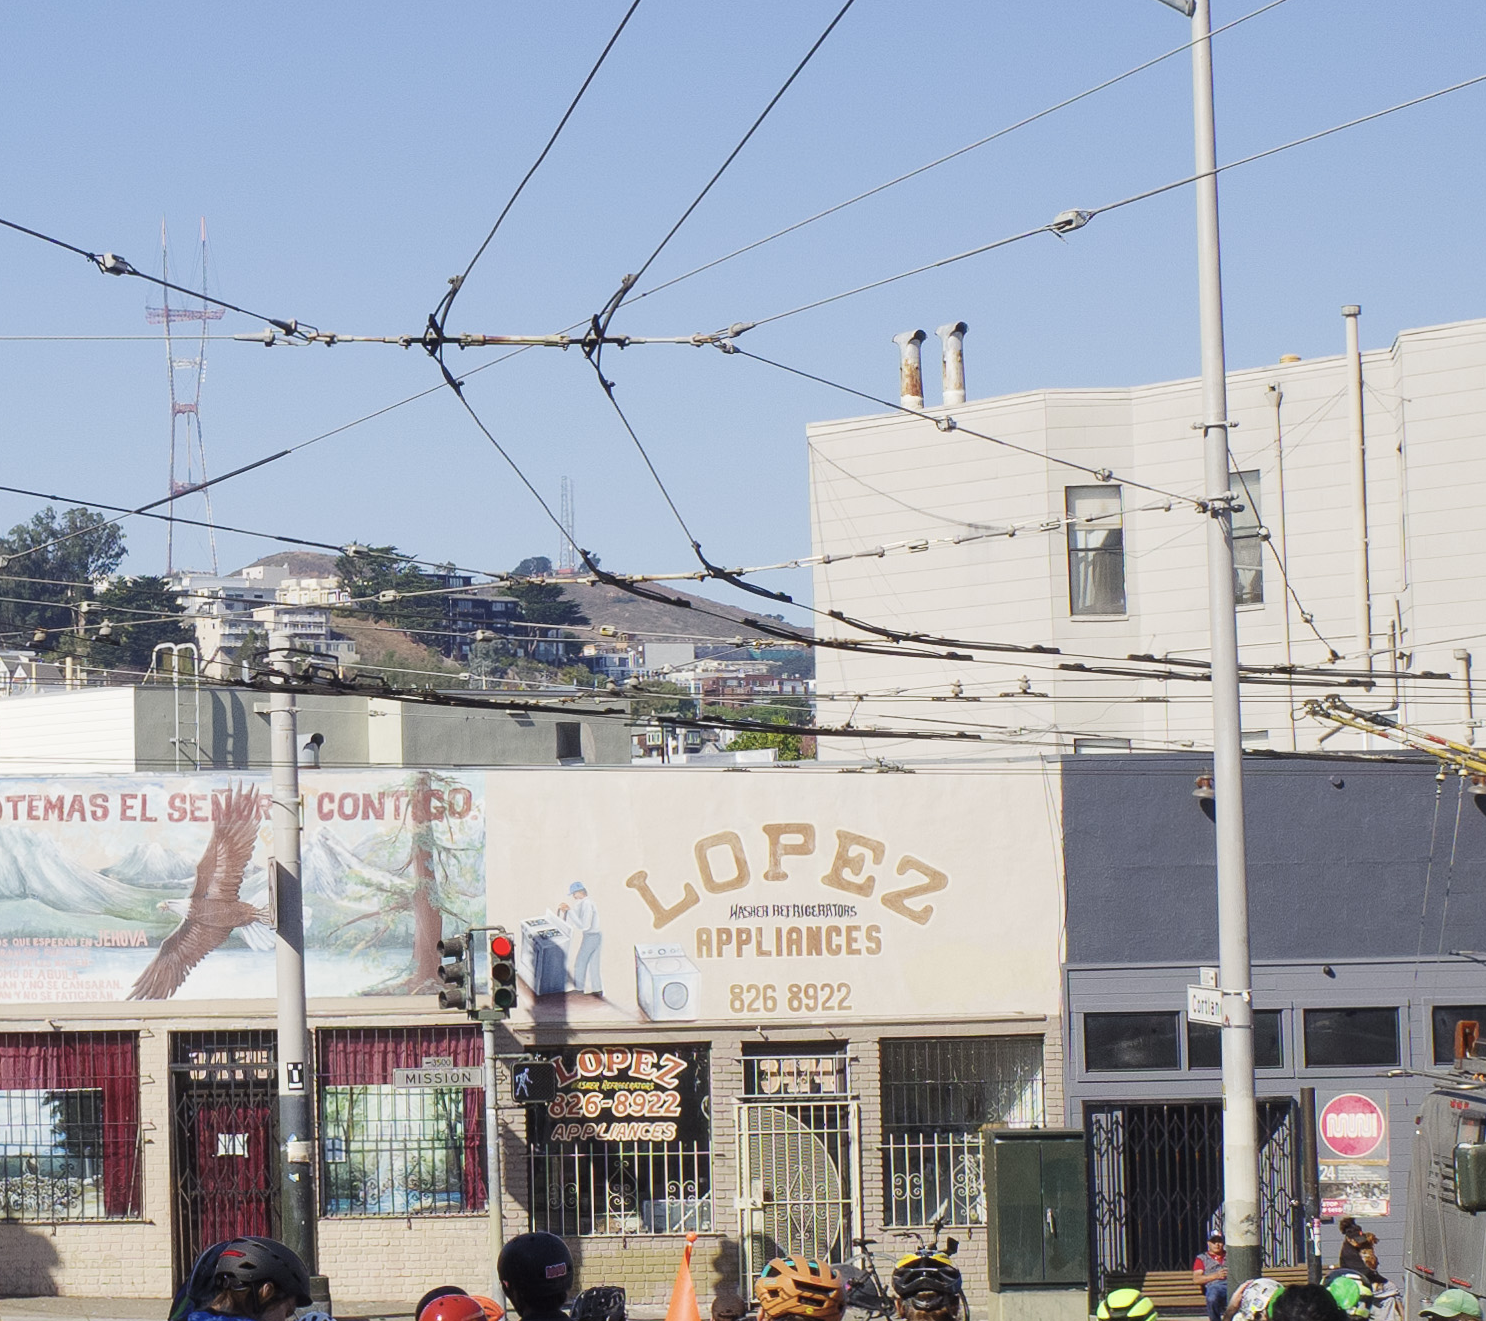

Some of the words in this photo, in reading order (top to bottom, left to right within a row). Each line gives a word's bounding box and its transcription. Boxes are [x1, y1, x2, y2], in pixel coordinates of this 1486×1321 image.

[119, 793, 157, 822] EL
[626, 822, 948, 930] LOPEZ
[12, 938, 31, 948] QUE
[33, 937, 78, 948] ESPERAN
[94, 929, 149, 948] JEHOVA
[696, 925, 882, 958] APPLIANCES
[729, 983, 778, 1013] 826
[788, 982, 853, 1013] 8922
[1192, 993, 1222, 1016] Cortlan
[404, 1072, 472, 1084] MISSION
[552, 1047, 688, 1089] LOPEZ
[548, 1090, 682, 1119] 826-8922
[551, 1122, 677, 1141] APPLIANCES
[1319, 1165, 1336, 1181] 24
